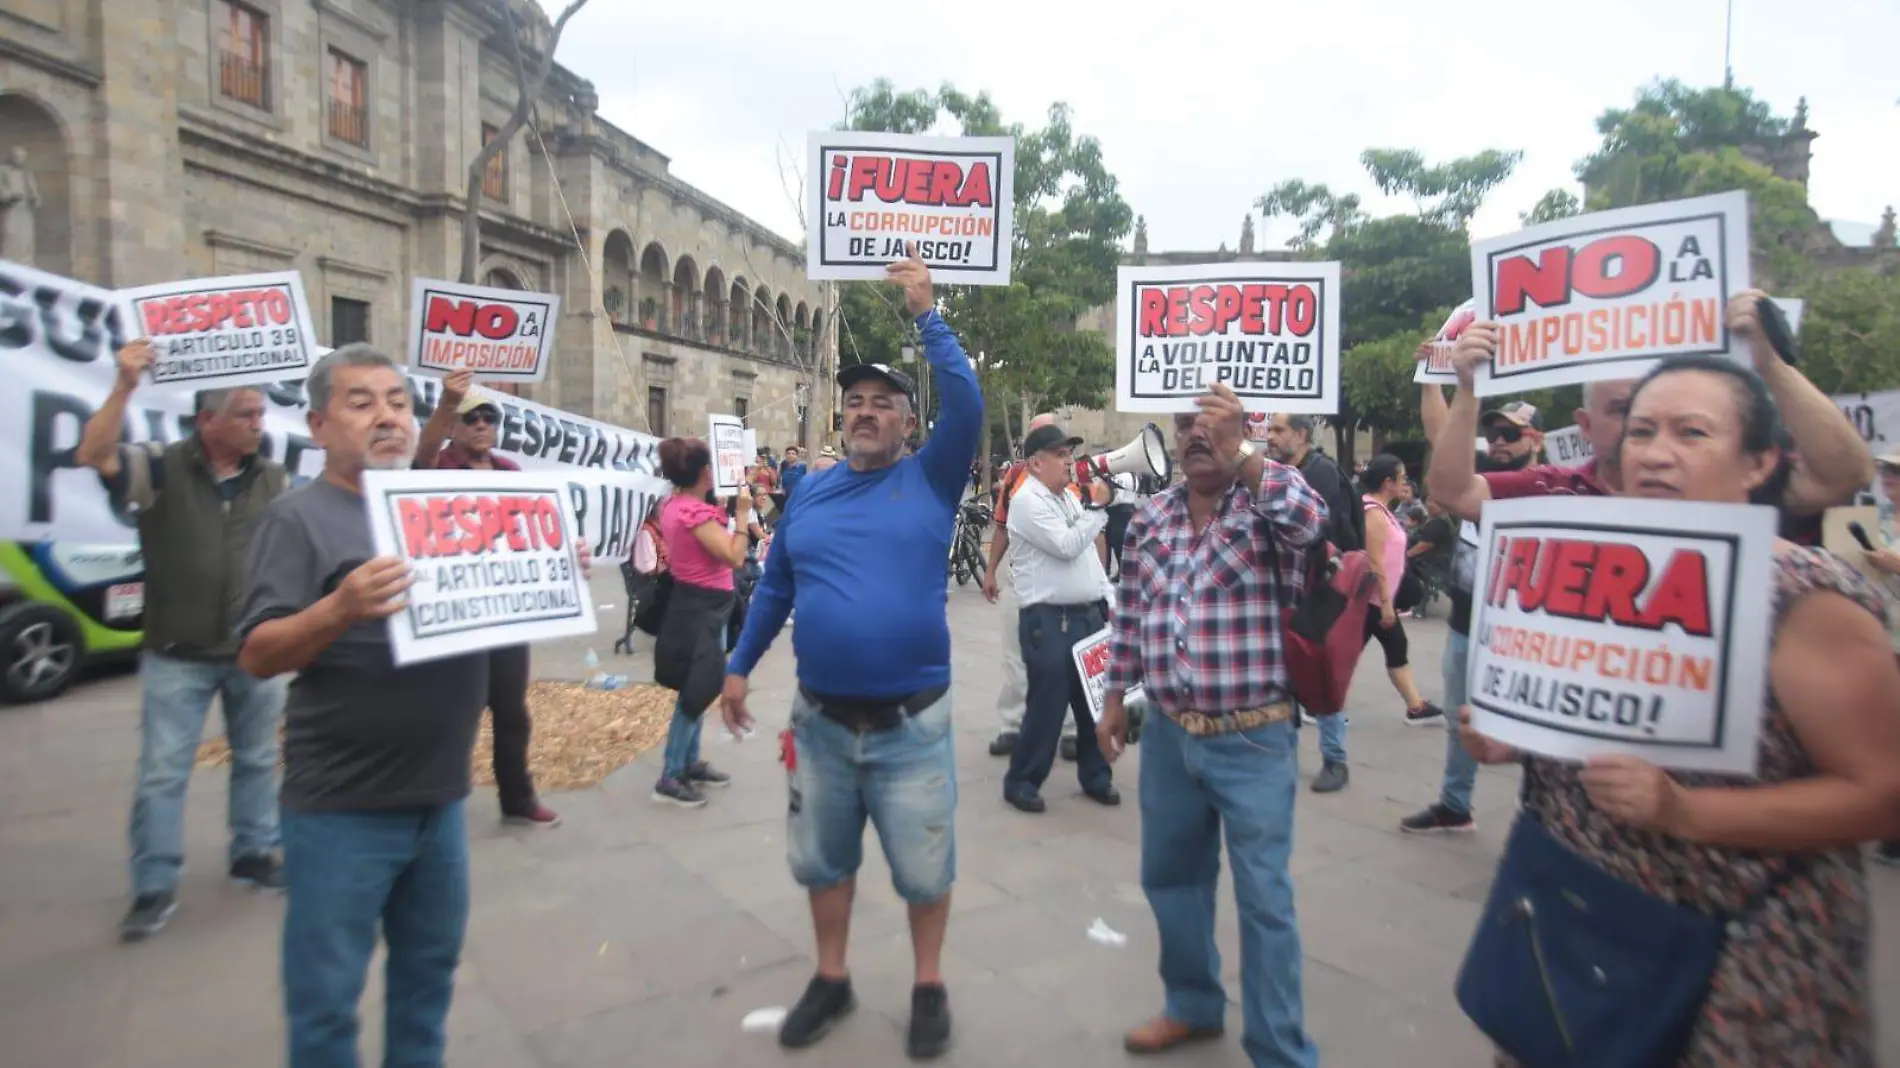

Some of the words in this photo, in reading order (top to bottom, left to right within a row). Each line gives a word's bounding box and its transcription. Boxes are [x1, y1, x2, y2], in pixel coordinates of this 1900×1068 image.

[827, 154, 993, 207] ¡FUERA
[827, 211, 847, 227] LA
[851, 211, 993, 236] CORRUPCIÓN
[849, 237, 877, 257] DE
[1494, 234, 1662, 317] NO
[1676, 234, 1702, 259] A
[1669, 257, 1715, 283] LA
[143, 287, 292, 337] RESPETO
[426, 296, 520, 340] NO
[526, 311, 537, 324] A
[520, 323, 539, 337] LA
[1140, 284, 1318, 338] RESPETO
[1498, 291, 1717, 367] IMPOSICIÓN
[268, 328, 297, 347] 39
[423, 337, 537, 369] IMPOSICIÓN
[1142, 344, 1155, 359] A
[1162, 340, 1311, 366] VOLUNTAD
[155, 347, 302, 377] CONSTITUCIONAL
[1138, 358, 1161, 374] LA
[1162, 366, 1208, 391] DEL
[1216, 365, 1314, 391] PUEBLO
[500, 402, 608, 470] ESPETA
[397, 494, 563, 560] RESPETO
[436, 556, 540, 593] ARTÍCULO
[546, 557, 570, 582] 39
[1486, 535, 1714, 638] ¡FUERA
[417, 586, 578, 627] CONSTITUCIONAL
[1490, 623, 1716, 693] CORRUPCIÓN
[1482, 663, 1506, 698] DE
[1504, 671, 1665, 736] JALISCO!
